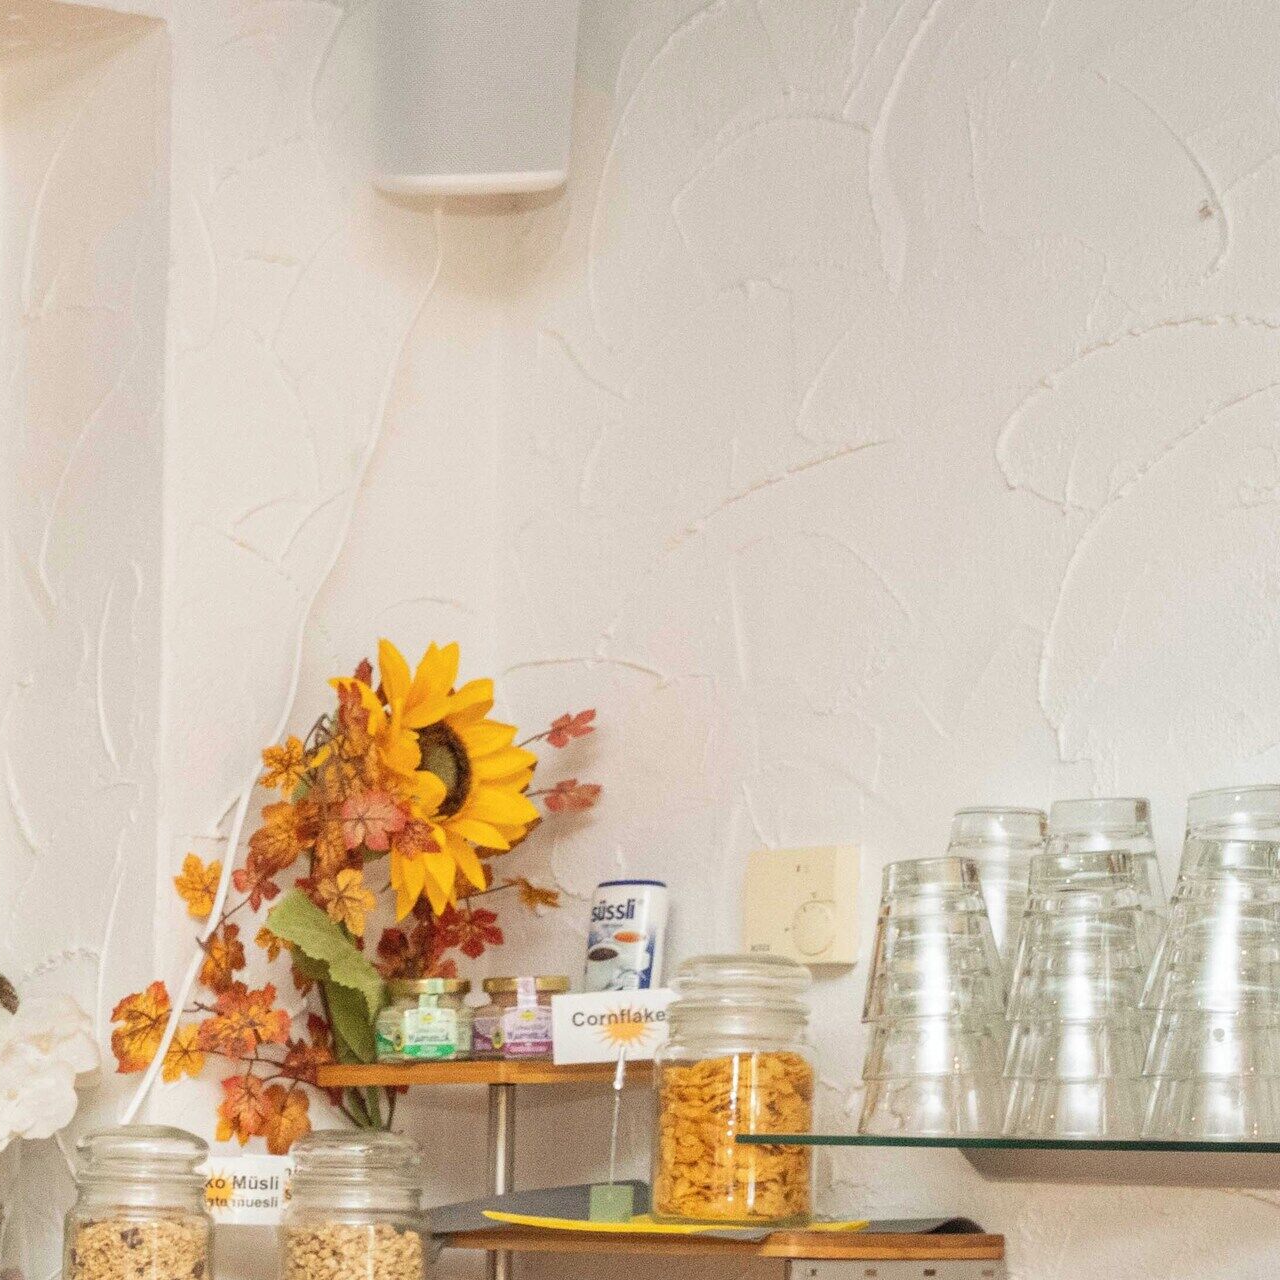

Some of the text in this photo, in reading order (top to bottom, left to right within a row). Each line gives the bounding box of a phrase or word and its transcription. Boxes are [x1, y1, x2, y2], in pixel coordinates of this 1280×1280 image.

[591, 898, 636, 923] süssli
[572, 1008, 666, 1028] Cornflake
[232, 1175, 279, 1190] Müsli
